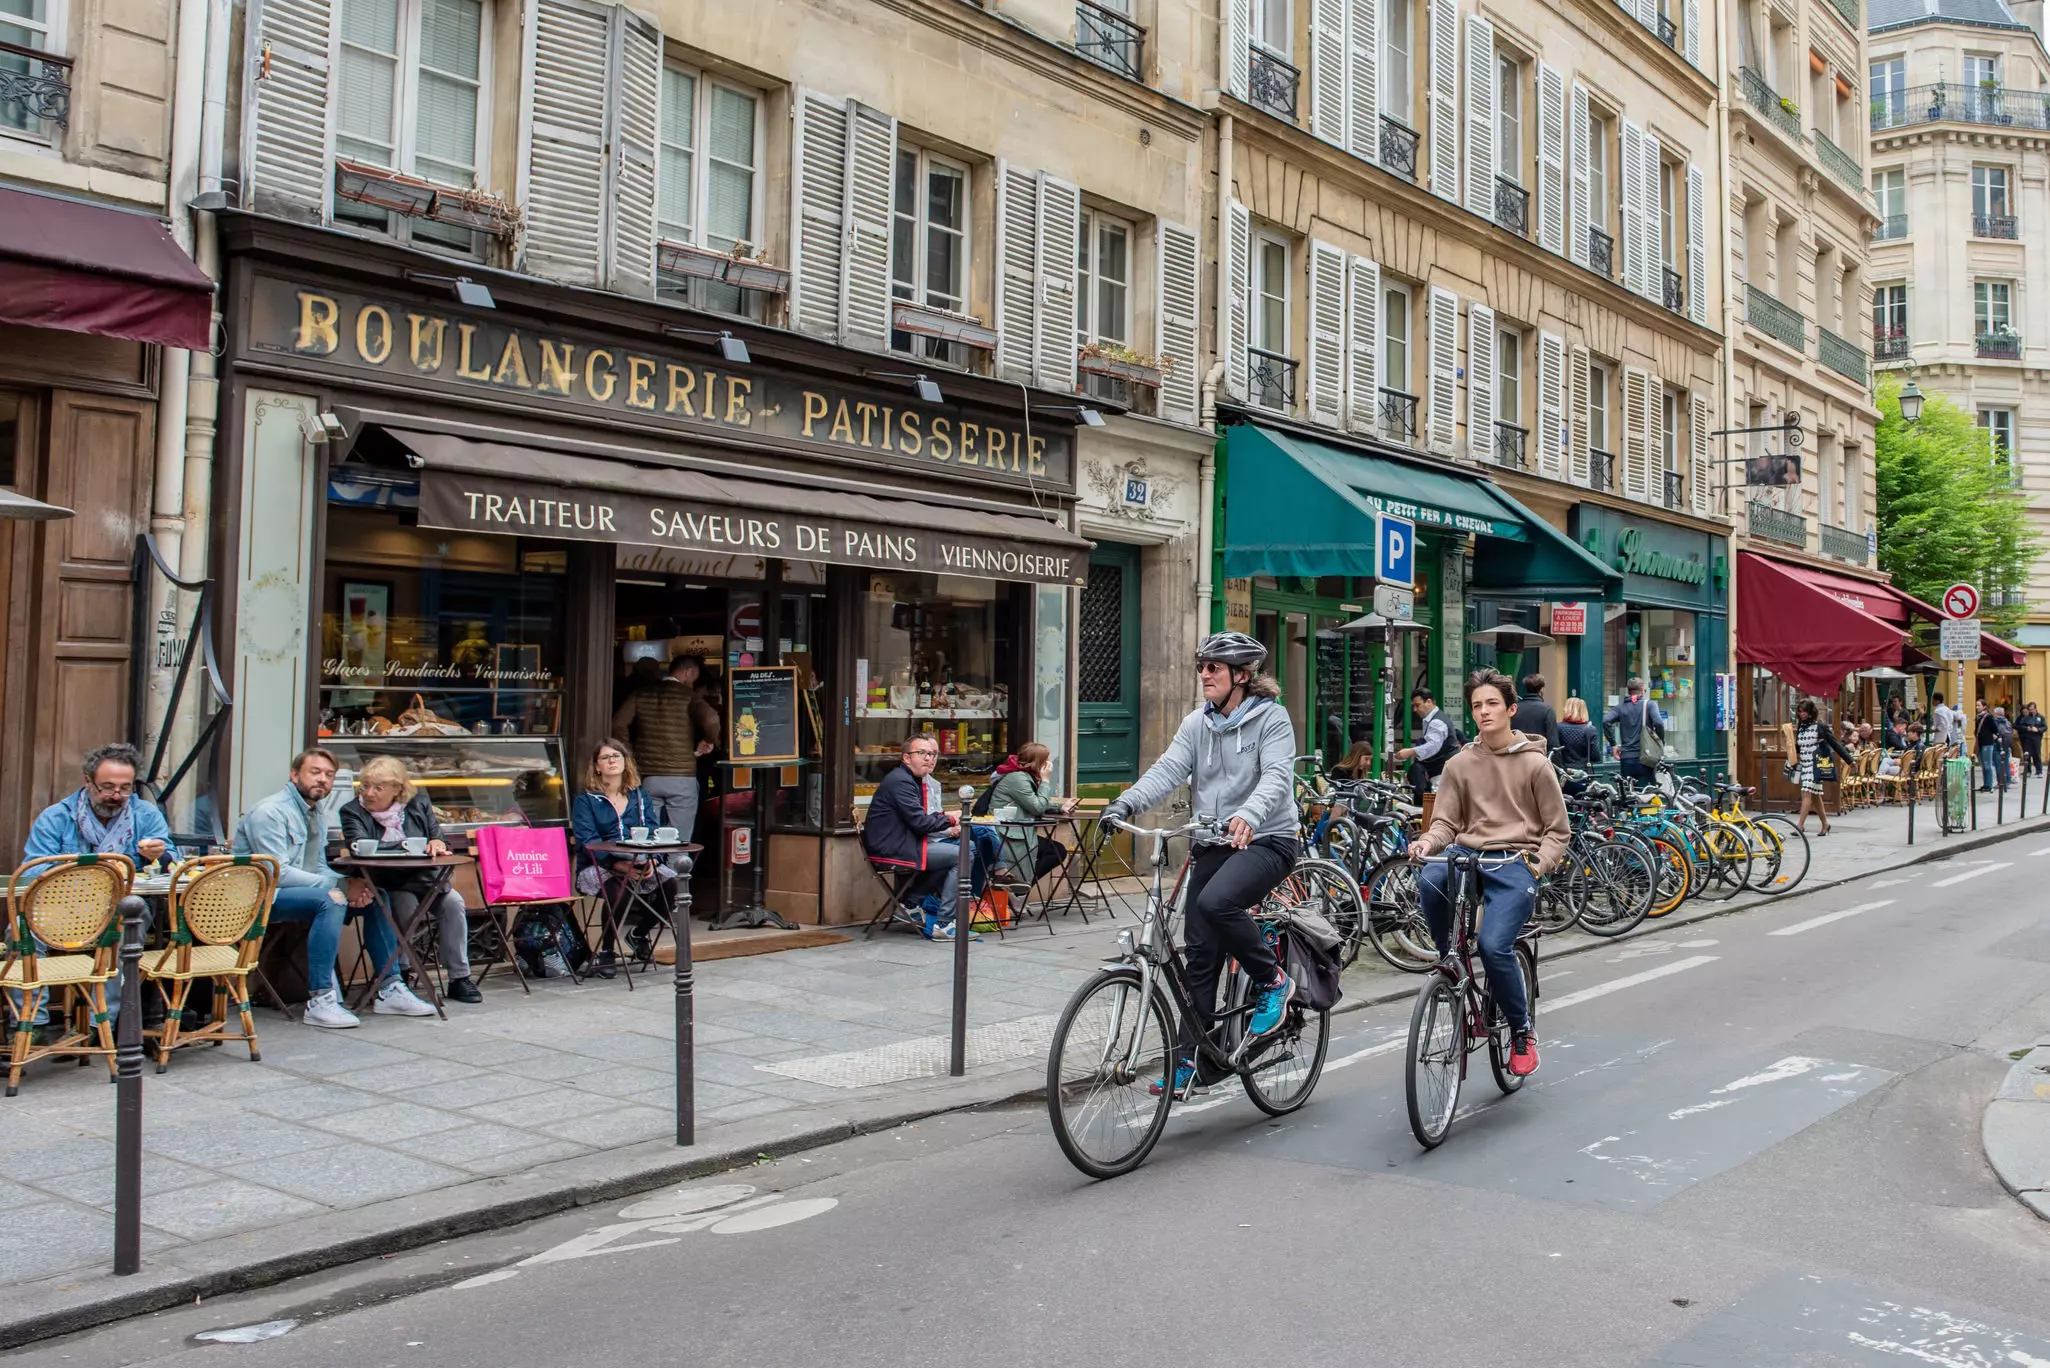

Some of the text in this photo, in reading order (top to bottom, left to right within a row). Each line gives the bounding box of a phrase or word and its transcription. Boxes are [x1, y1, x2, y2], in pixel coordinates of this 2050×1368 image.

[296, 289, 753, 429] BOULANGERIE
[801, 390, 1048, 477] PATISSERIE
[1129, 482, 1144, 501] 32
[1366, 495, 1494, 534] AU PETIT FER A CHEVAL
[463, 491, 1070, 579] TRAITEUR SAVEURS DE PAINS VIENNOISERIE
[1389, 529, 1405, 571] P
[322, 657, 551, 681] Glaces Sandwichs Viennoiserie
[507, 849, 549, 861] Antoine
[512, 862, 544, 875] & Lili
